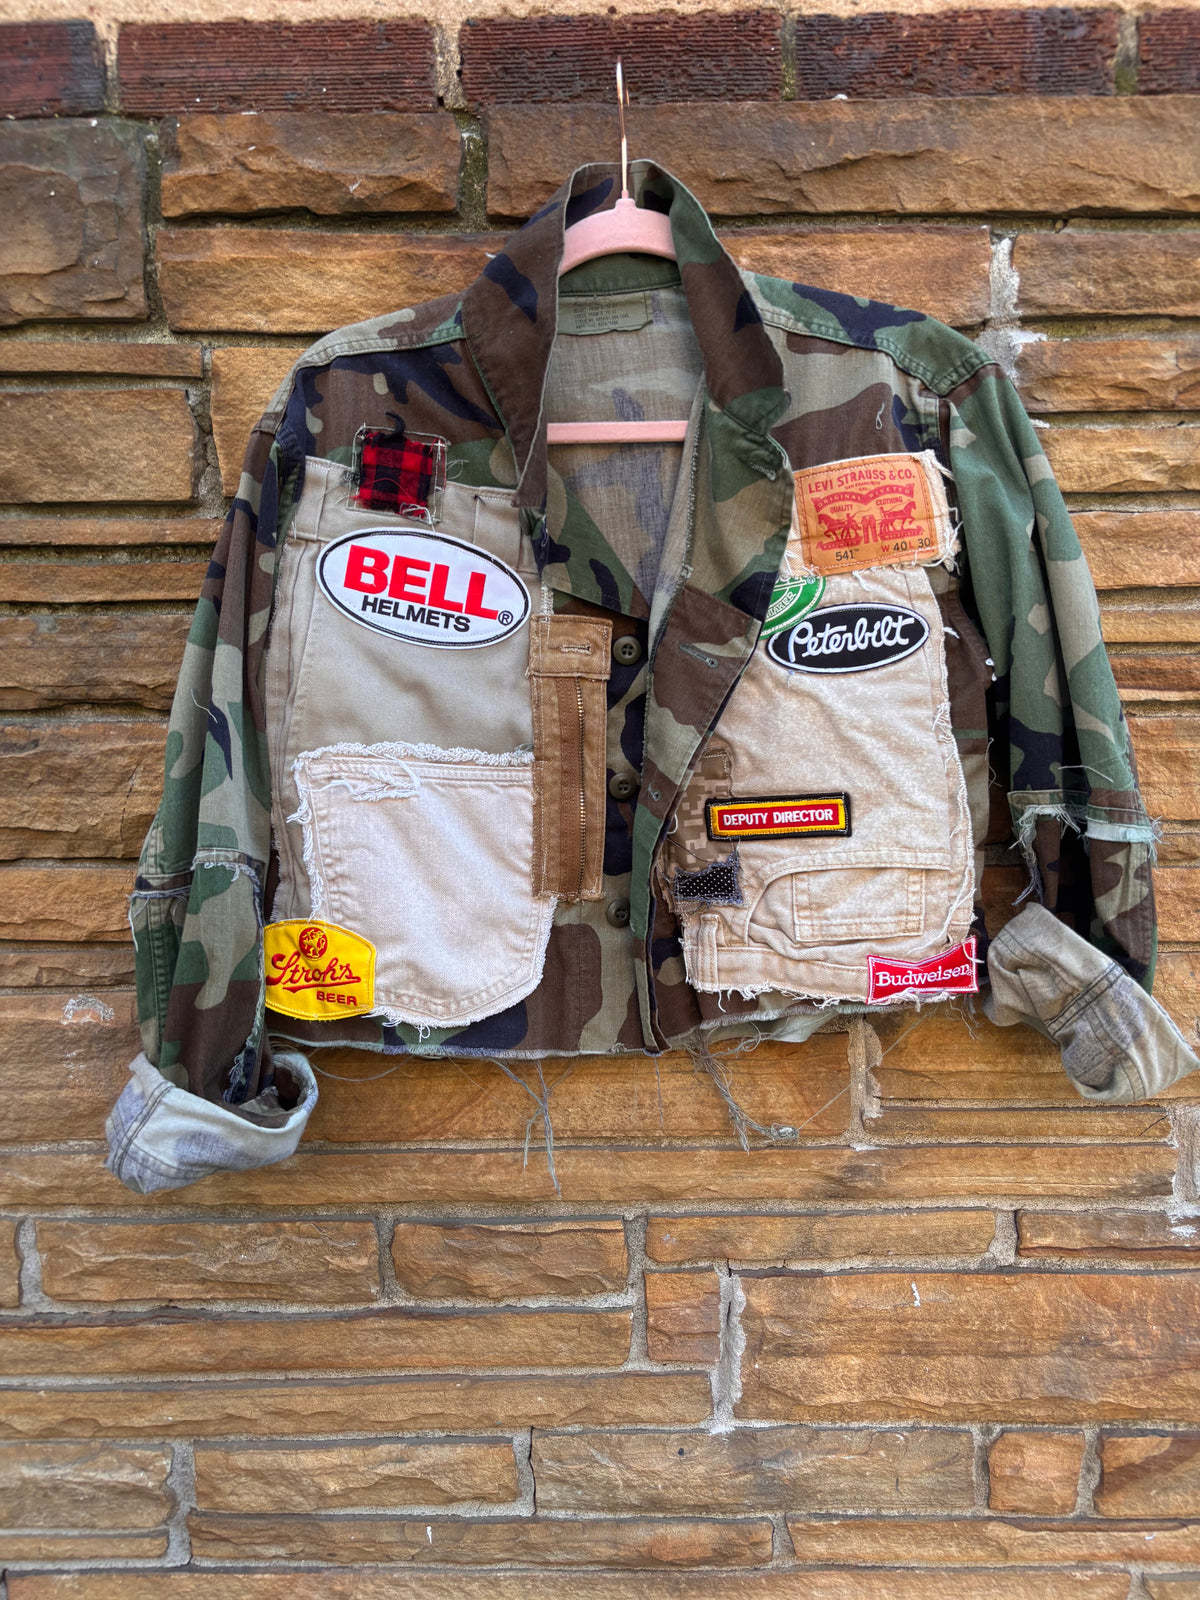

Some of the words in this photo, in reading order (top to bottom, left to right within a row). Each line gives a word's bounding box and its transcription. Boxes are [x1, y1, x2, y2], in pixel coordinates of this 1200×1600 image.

[808, 479, 833, 494] LEVI
[836, 469, 886, 488] STRAUSS
[888, 470, 896, 480] &
[897, 468, 915, 480] CO.
[816, 493, 862, 508] ORIGINAL
[868, 485, 909, 498] RIVETED
[829, 503, 853, 514] QUALITY
[875, 496, 903, 506] CLOTHING
[881, 544, 890, 552] W
[893, 541, 907, 551] 40
[908, 541, 914, 549] L
[917, 537, 931, 548] 30
[343, 544, 499, 621] BELL
[361, 595, 471, 633] HELMETS
[787, 615, 915, 663] Peterbilt
[723, 812, 768, 826] DEPUTY
[772, 808, 834, 824] DIRECTOR
[265, 950, 361, 986] Stroh's
[875, 964, 971, 987] Budweiser
[316, 990, 358, 1007] BEER
